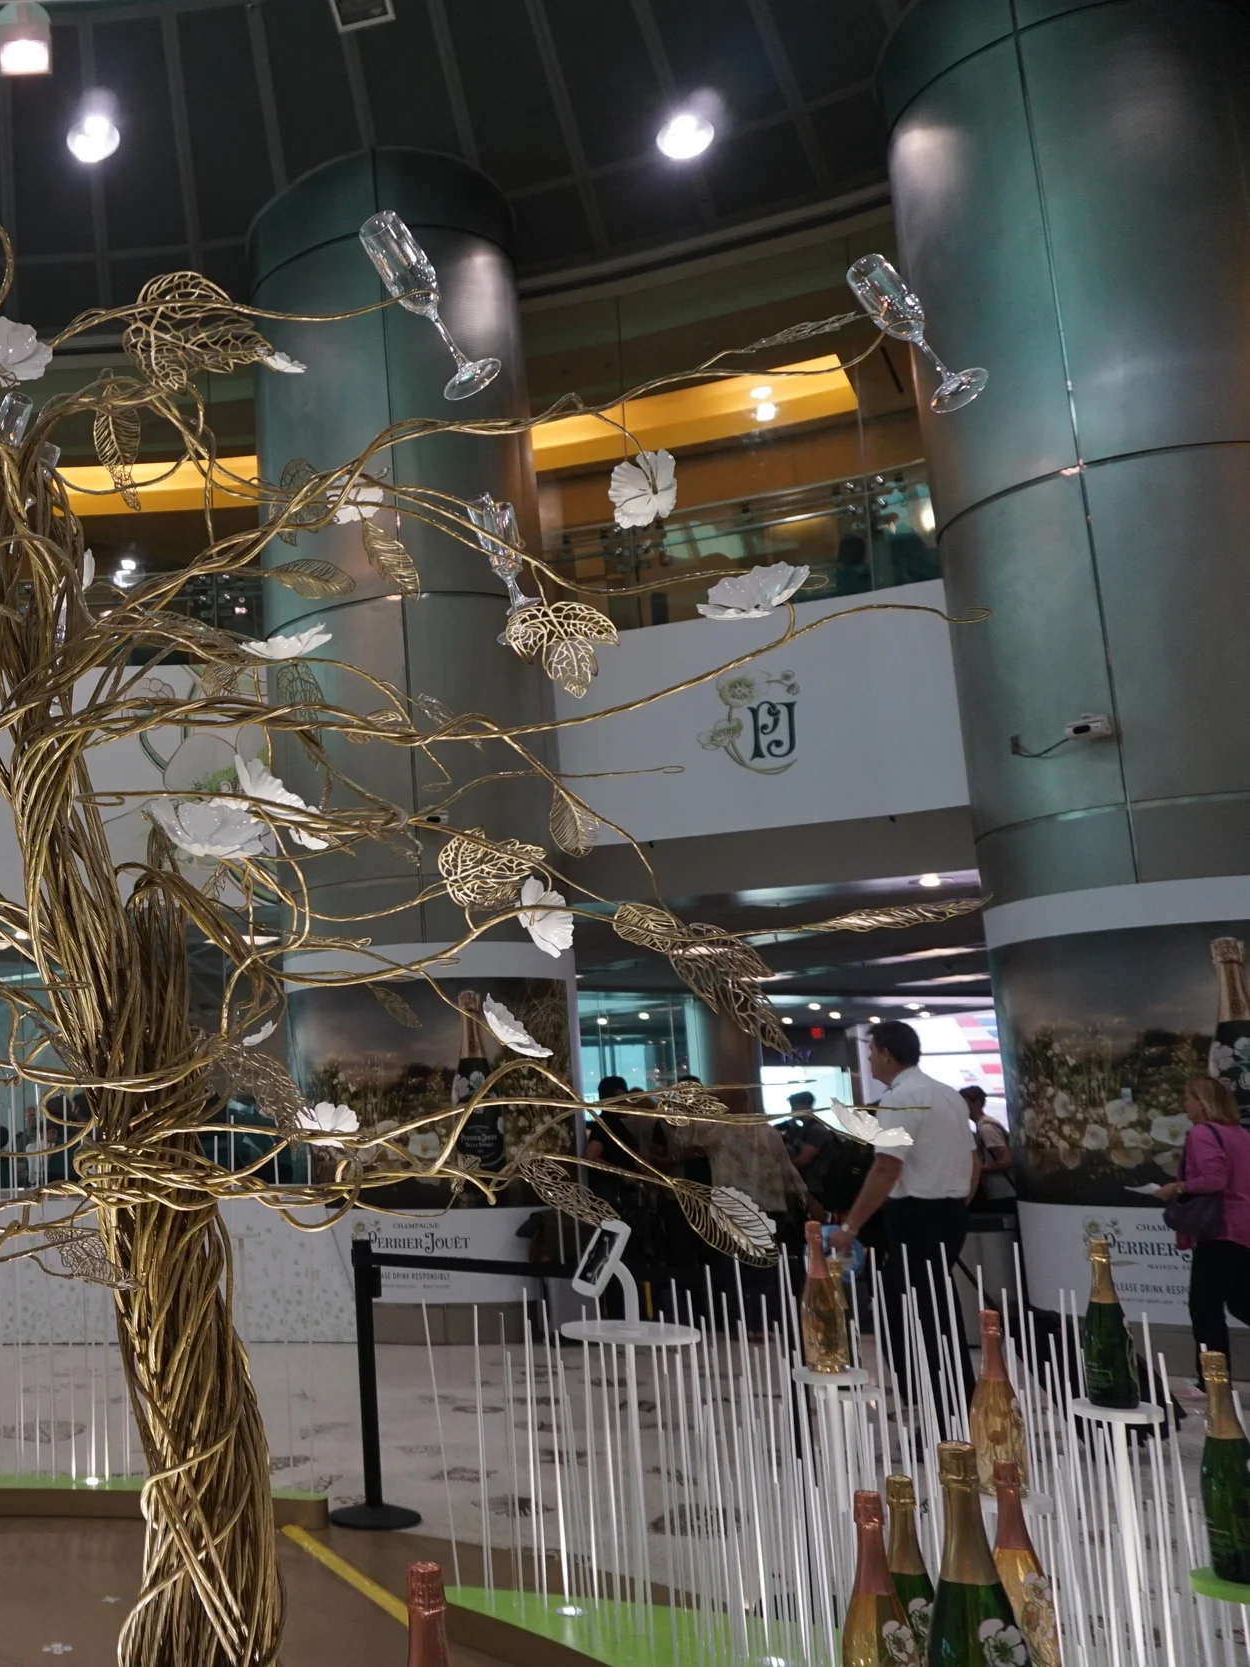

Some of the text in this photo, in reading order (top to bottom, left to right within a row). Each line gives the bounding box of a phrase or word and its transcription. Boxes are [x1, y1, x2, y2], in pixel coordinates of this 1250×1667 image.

[747, 700, 798, 761] PJ
[411, 1272, 450, 1281] RESPONSIBLY
[1115, 1282, 1138, 1293] LEASE
[1140, 1283, 1164, 1294] DRINK
